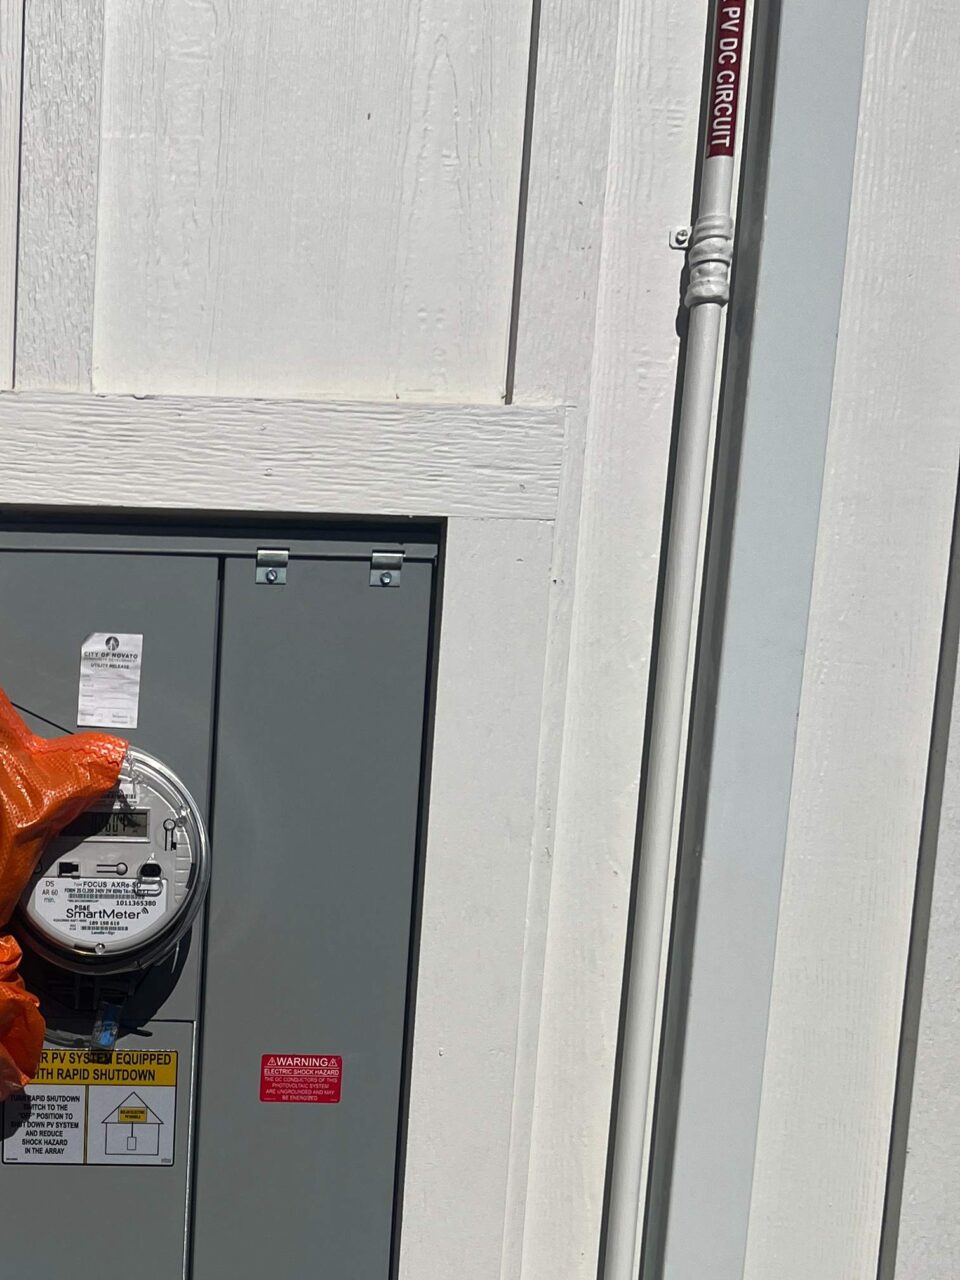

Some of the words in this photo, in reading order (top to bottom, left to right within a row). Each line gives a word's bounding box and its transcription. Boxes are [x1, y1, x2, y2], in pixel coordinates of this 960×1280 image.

[721, 7, 741, 32] PV
[718, 38, 738, 65] DC
[711, 70, 736, 148] CIRCUIT
[66, 908, 141, 919] SmartMeter
[51, 1052, 66, 1064] PV
[69, 1052, 113, 1065] SYSTEM
[116, 1053, 172, 1065] EQUIPPED
[276, 1057, 328, 1066] WARNING
[57, 1068, 90, 1080] RAPID
[93, 1069, 156, 1081] SHUTDOWN
[27, 1094, 46, 1102] RAPID
